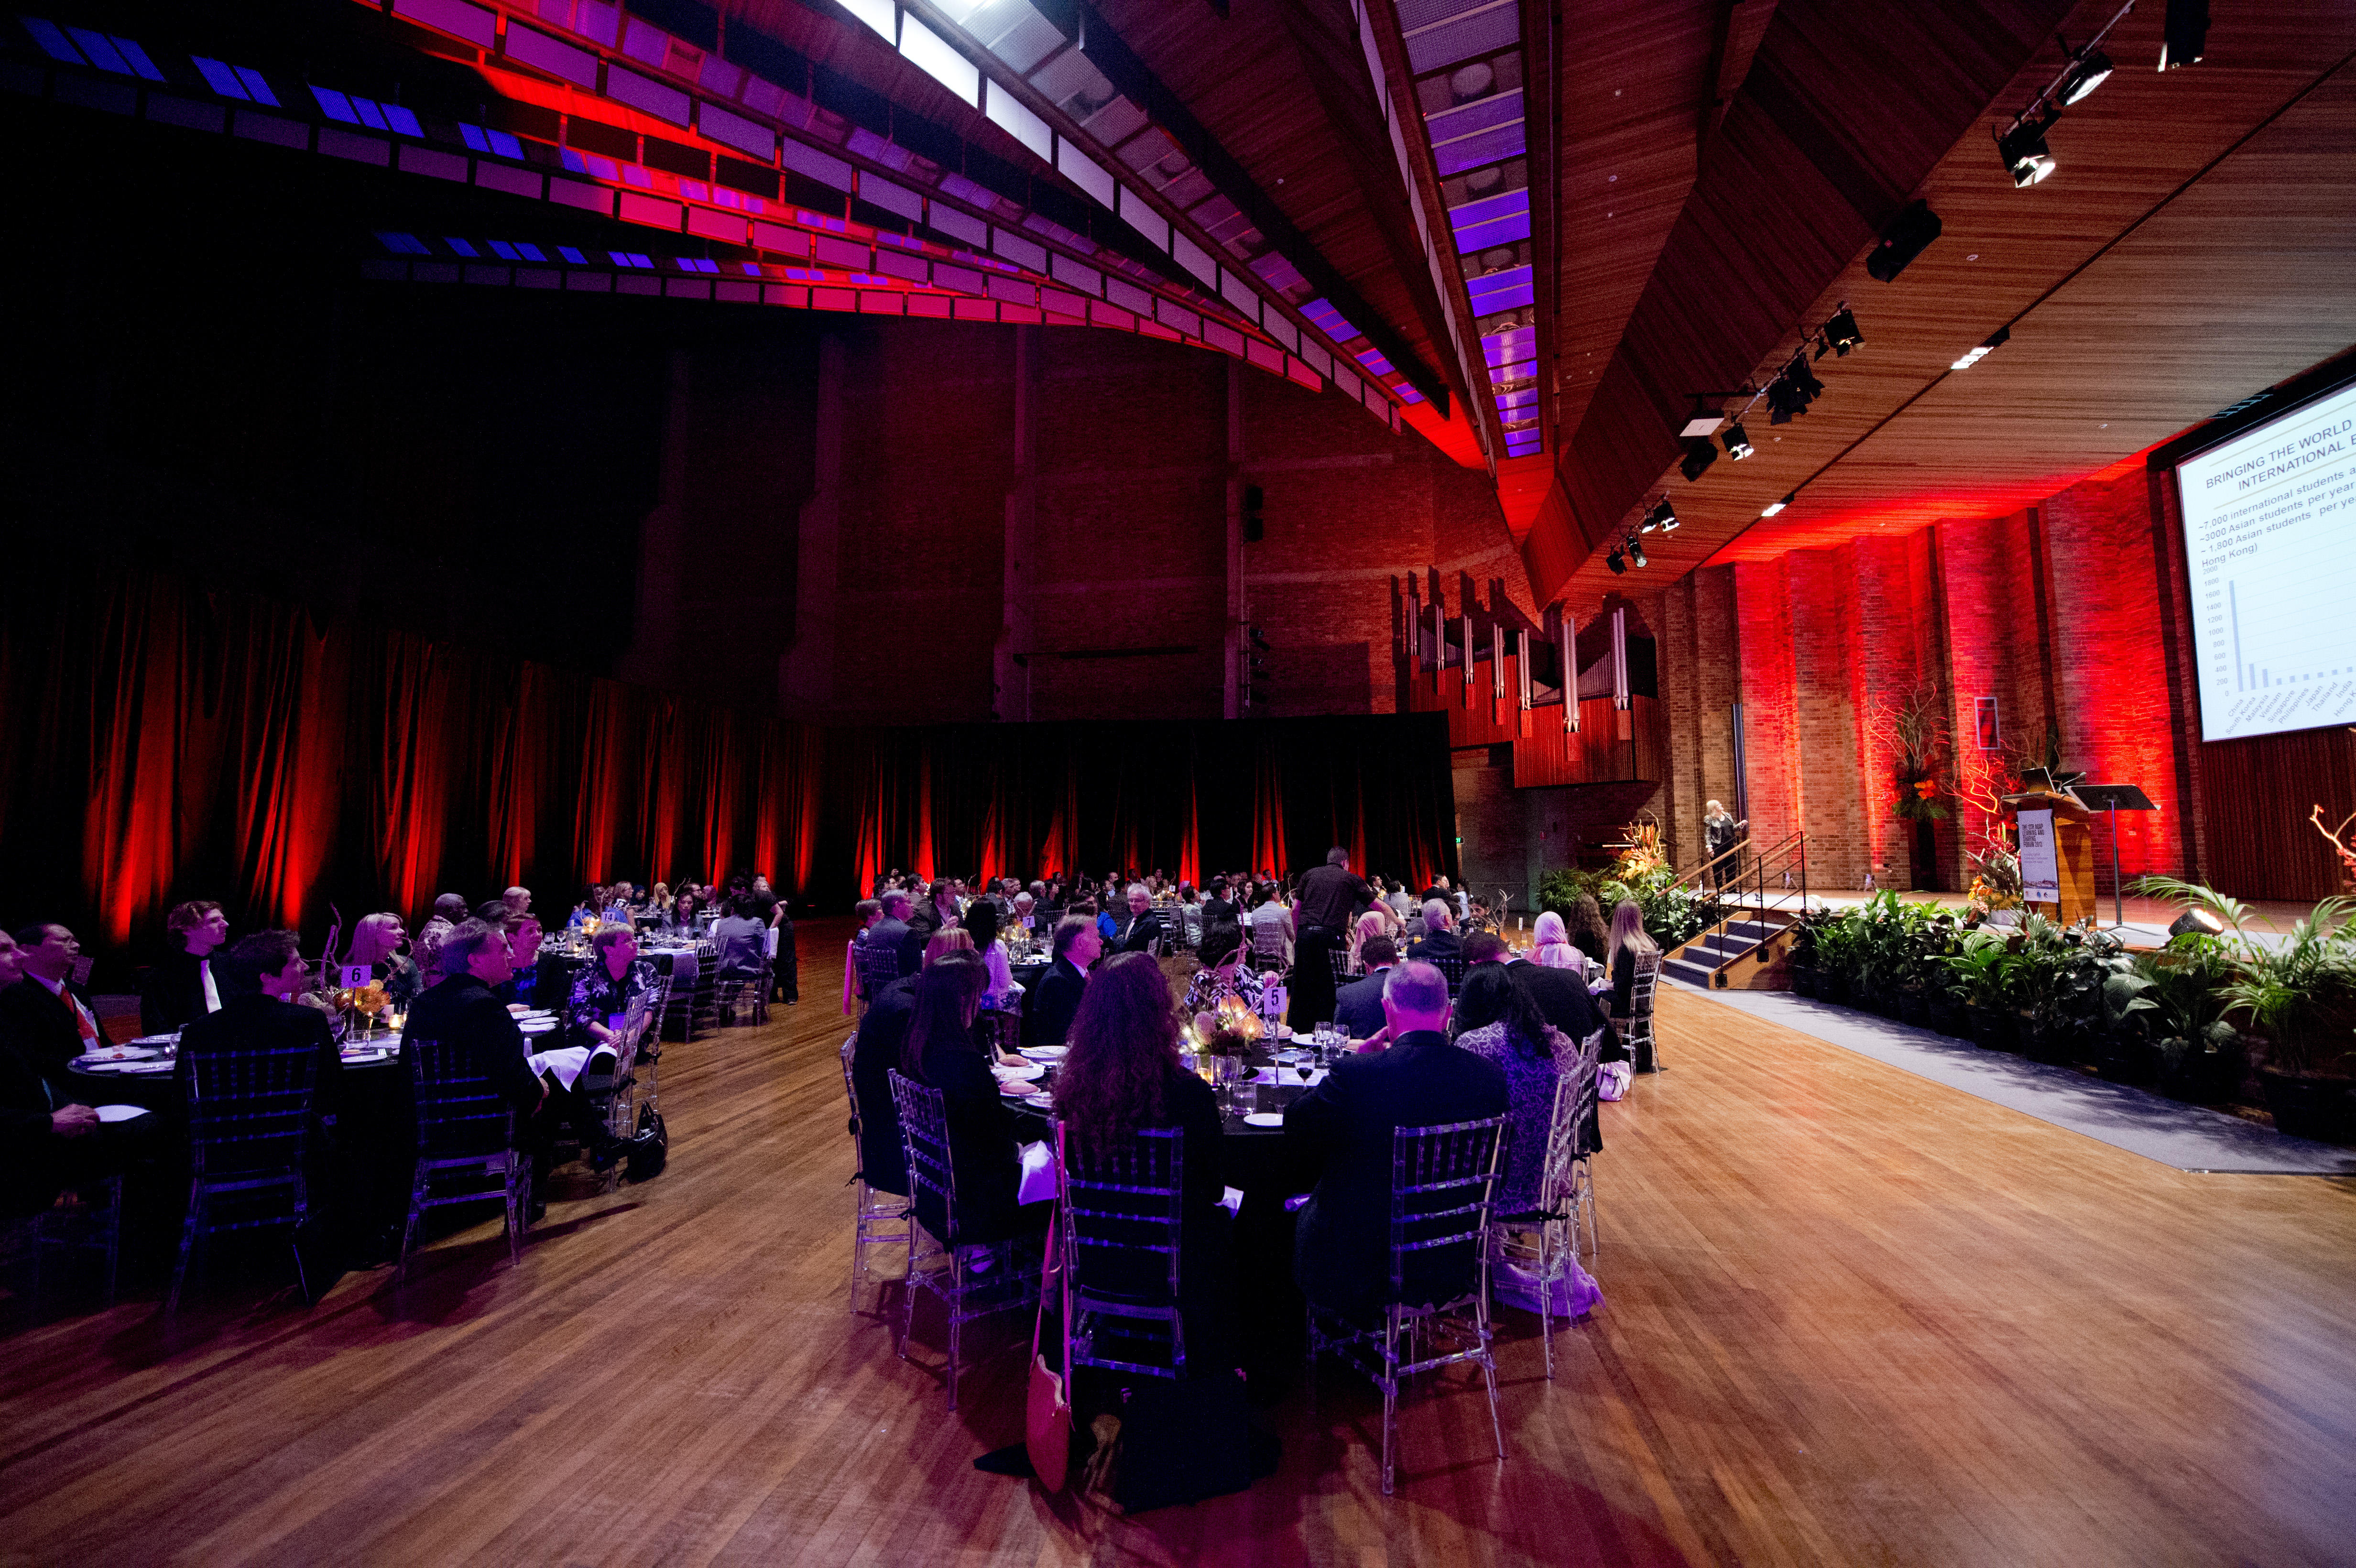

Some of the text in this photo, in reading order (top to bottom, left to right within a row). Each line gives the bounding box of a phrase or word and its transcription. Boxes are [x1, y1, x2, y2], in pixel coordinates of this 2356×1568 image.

[2206, 420, 2352, 489] BRINGING THE WORLD
[2238, 441, 2345, 490] INTERNATIONAL
[2231, 490, 2292, 520] international
[2297, 471, 2344, 495] students
[2200, 482, 2355, 542] ~3000 Asian students per year
[2236, 529, 2262, 544] Asian
[2266, 511, 2311, 533] students
[2320, 502, 2337, 516] per
[2341, 496, 2356, 509] ye
[2202, 543, 2258, 567] Hong Kong)
[2203, 565, 2218, 575] 2000
[2204, 577, 2219, 587] 1800
[2205, 590, 2220, 599] 1600
[2207, 602, 2221, 611] 1400
[2207, 615, 2222, 623] 1200
[2209, 627, 2223, 636] 1000
[2306, 686, 2323, 707] Japan
[2312, 682, 2338, 712] Thailand
[2336, 681, 2353, 698] India
[2225, 697, 2256, 735] South Korea
[2228, 699, 2244, 717] China
[2246, 695, 2269, 722] Malaysia
[2259, 692, 2282, 718] Vietnam
[2268, 690, 2295, 723] Singapore
[2278, 688, 2309, 724] Philippines
[2334, 698, 2353, 717] Hong
[352, 968, 360, 982] 6
[1272, 989, 1279, 1006] 5
